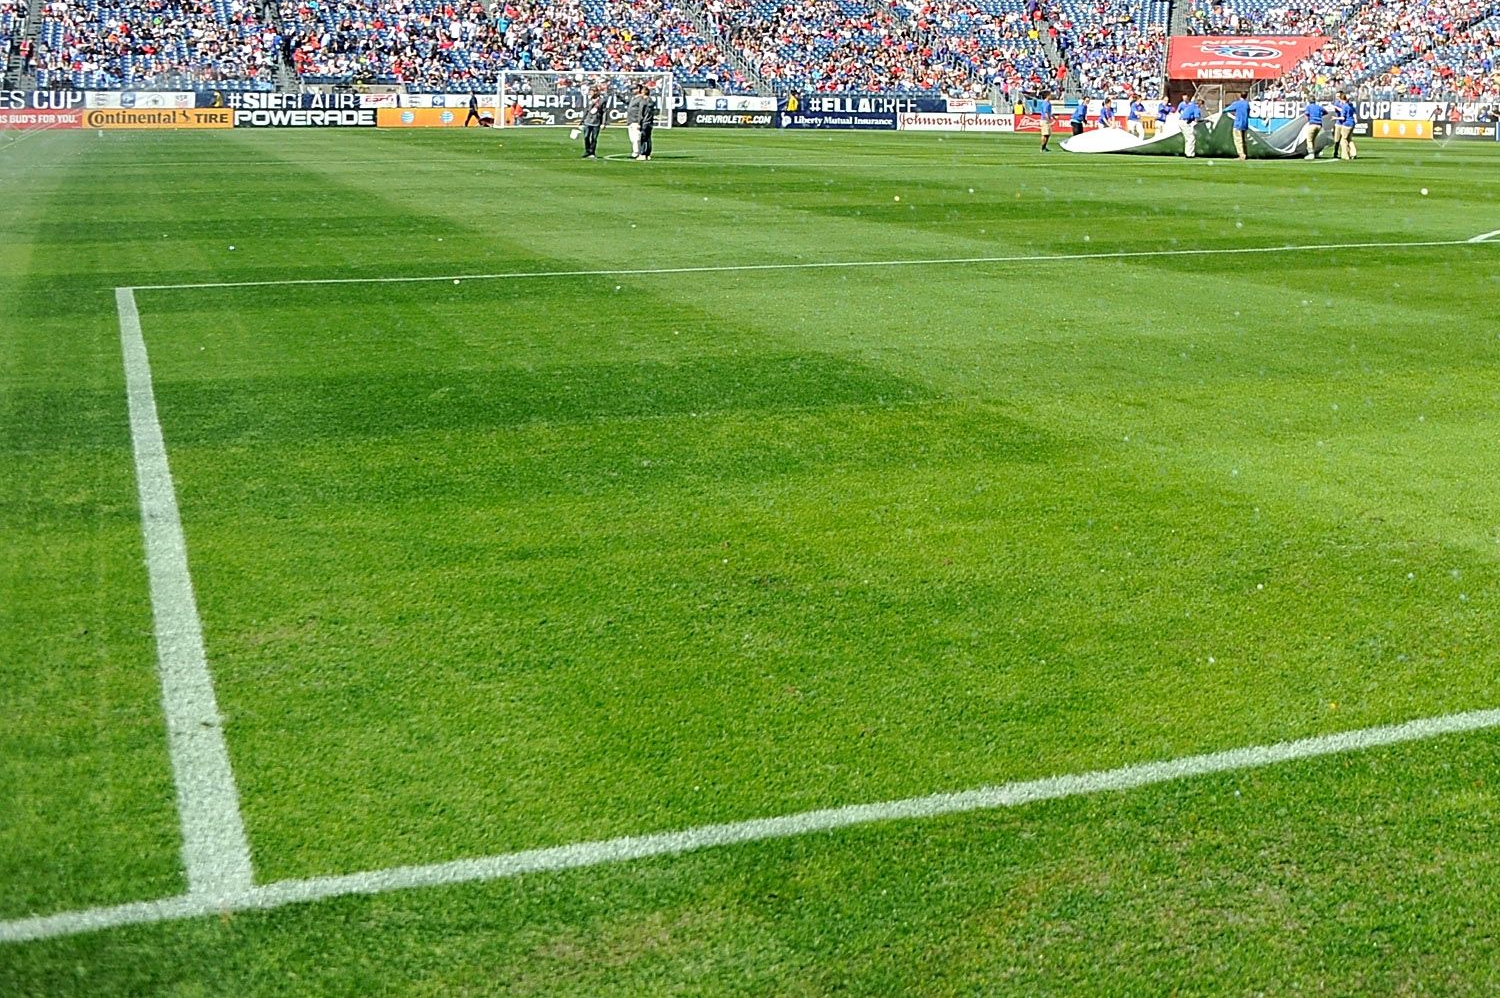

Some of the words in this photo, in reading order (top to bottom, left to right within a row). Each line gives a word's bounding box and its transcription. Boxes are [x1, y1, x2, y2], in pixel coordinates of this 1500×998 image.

[1197, 69, 1254, 79] NISSAN
[32, 91, 82, 110] CUP
[9, 114, 36, 123] BUD'S
[38, 114, 56, 123] FOR
[57, 114, 78, 123] YOU.
[88, 110, 177, 127] Continental
[195, 114, 229, 124] TIRE
[234, 110, 375, 126] POWERADE
[696, 114, 771, 125] CHEVROLETFC.COM
[1360, 104, 1391, 120] CUP
[794, 115, 823, 128] Liberty
[824, 116, 853, 125] Mutual
[854, 116, 893, 126] Insurance
[900, 112, 952, 131] Johnson
[960, 114, 1013, 132] Johnson
